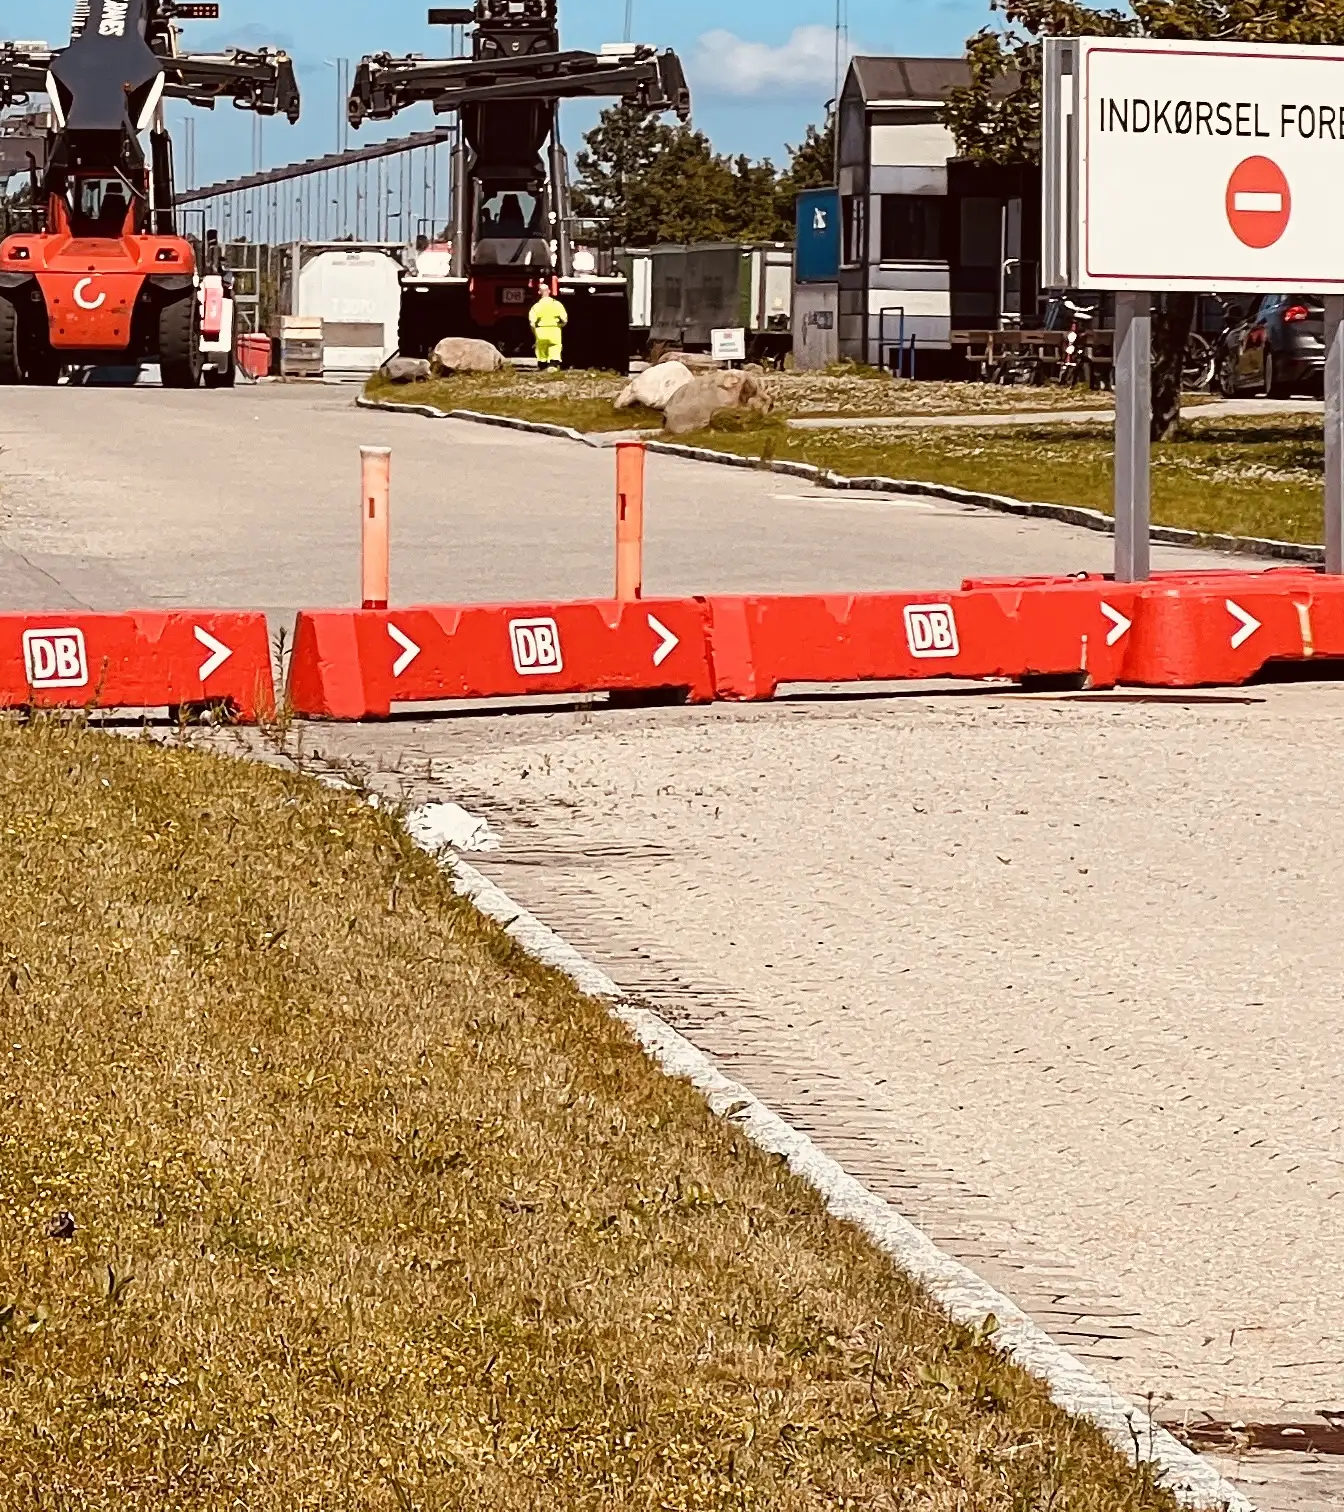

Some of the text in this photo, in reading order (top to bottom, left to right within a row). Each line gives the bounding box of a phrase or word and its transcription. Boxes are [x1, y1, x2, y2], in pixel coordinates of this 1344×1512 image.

[1099, 97, 1270, 138] INDKØRSEL
[515, 627, 556, 666] DB
[910, 613, 952, 650] DB
[30, 637, 80, 679] DB
